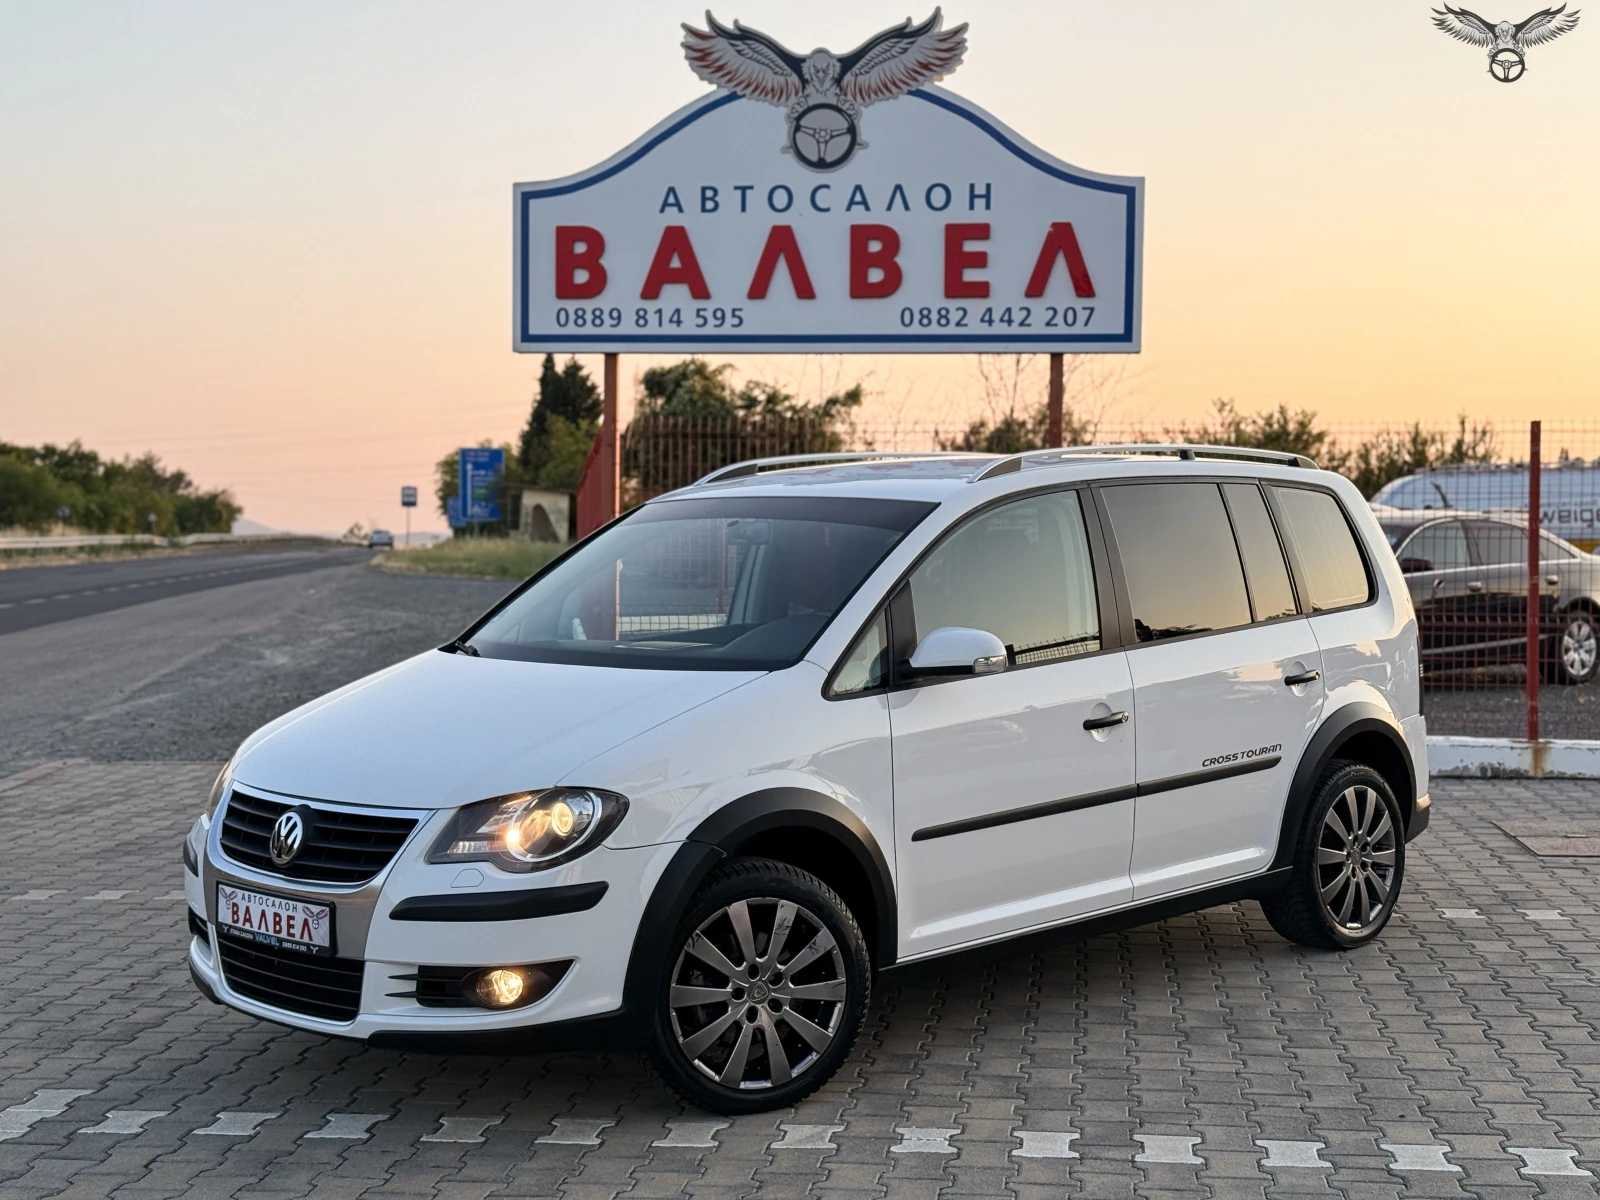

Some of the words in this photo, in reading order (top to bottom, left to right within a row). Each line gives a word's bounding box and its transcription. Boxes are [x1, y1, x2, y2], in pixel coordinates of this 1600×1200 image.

[659, 182, 992, 214] АВТОСАЛОН
[556, 222, 1095, 300] ВАЛВЕЛ
[556, 309, 622, 328] 0889
[634, 308, 684, 328] 814
[695, 307, 744, 328] 595
[901, 308, 969, 328] 0882
[979, 307, 1032, 327] 442
[1044, 306, 1096, 327] 207
[1202, 753, 1239, 767] CROSS
[1240, 743, 1282, 759] TOURAN
[270, 811, 303, 864] VW
[241, 892, 298, 913] АВТОСАЛОН
[231, 901, 313, 942] ВАЛВЕЛ
[254, 932, 280, 946] VALVEL
